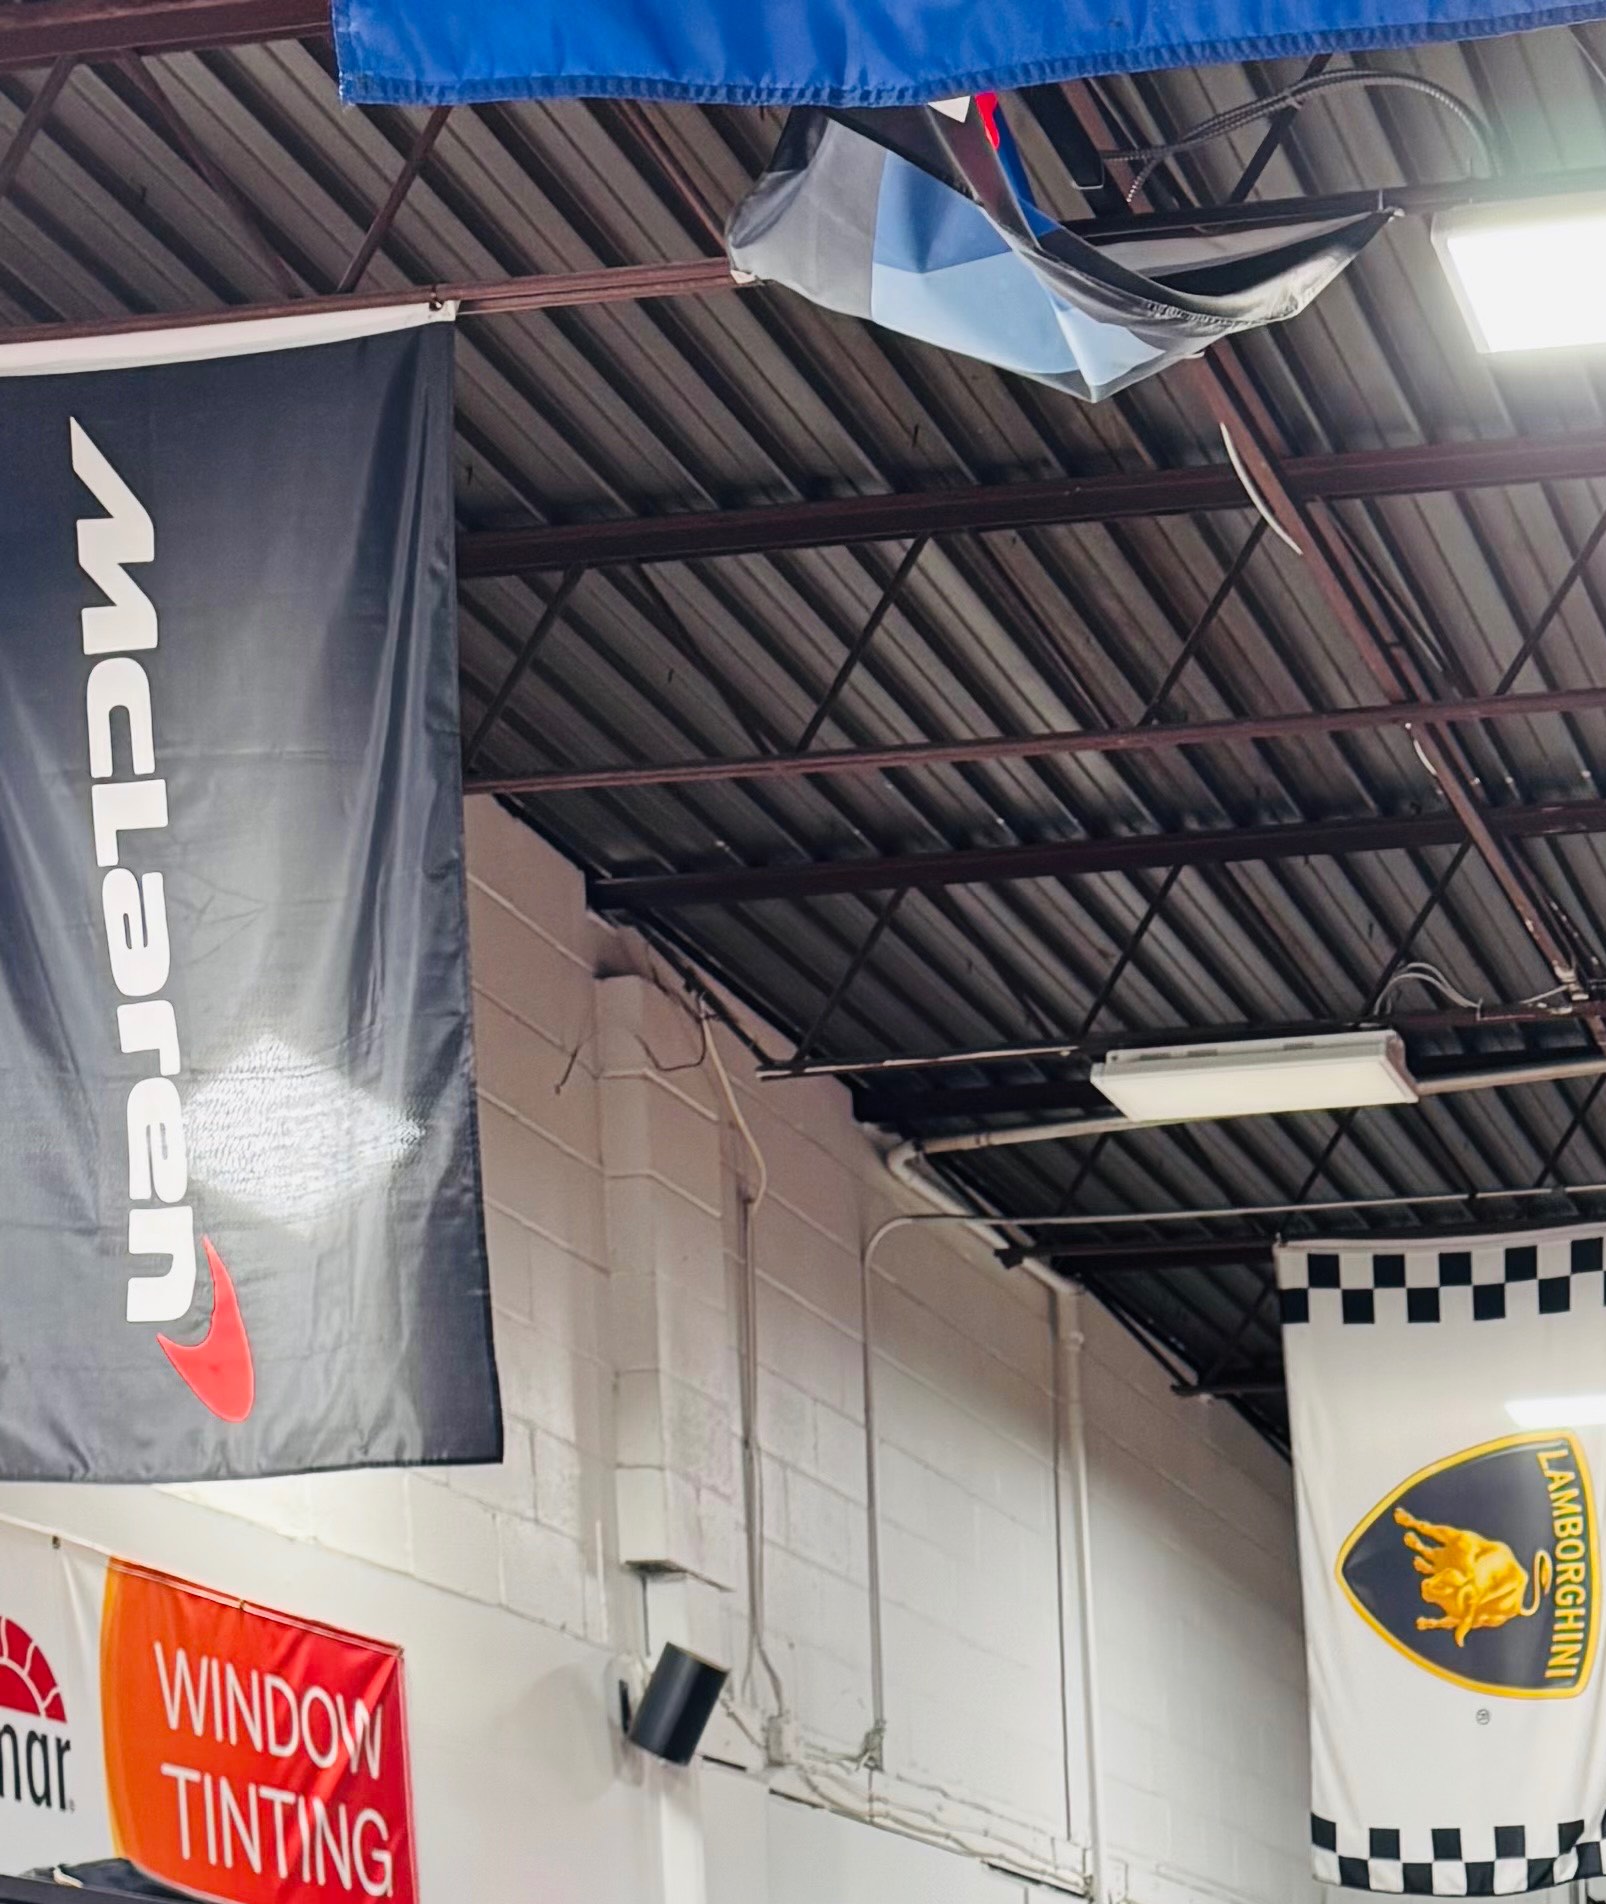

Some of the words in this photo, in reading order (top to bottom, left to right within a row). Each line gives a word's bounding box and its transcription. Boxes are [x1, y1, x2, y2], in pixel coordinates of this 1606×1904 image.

[70, 414, 197, 1322] McLaren
[1535, 1448, 1585, 1680] LAMBORGHINI
[153, 1640, 383, 1781] WINDOW
[160, 1763, 394, 1898] TINTING
